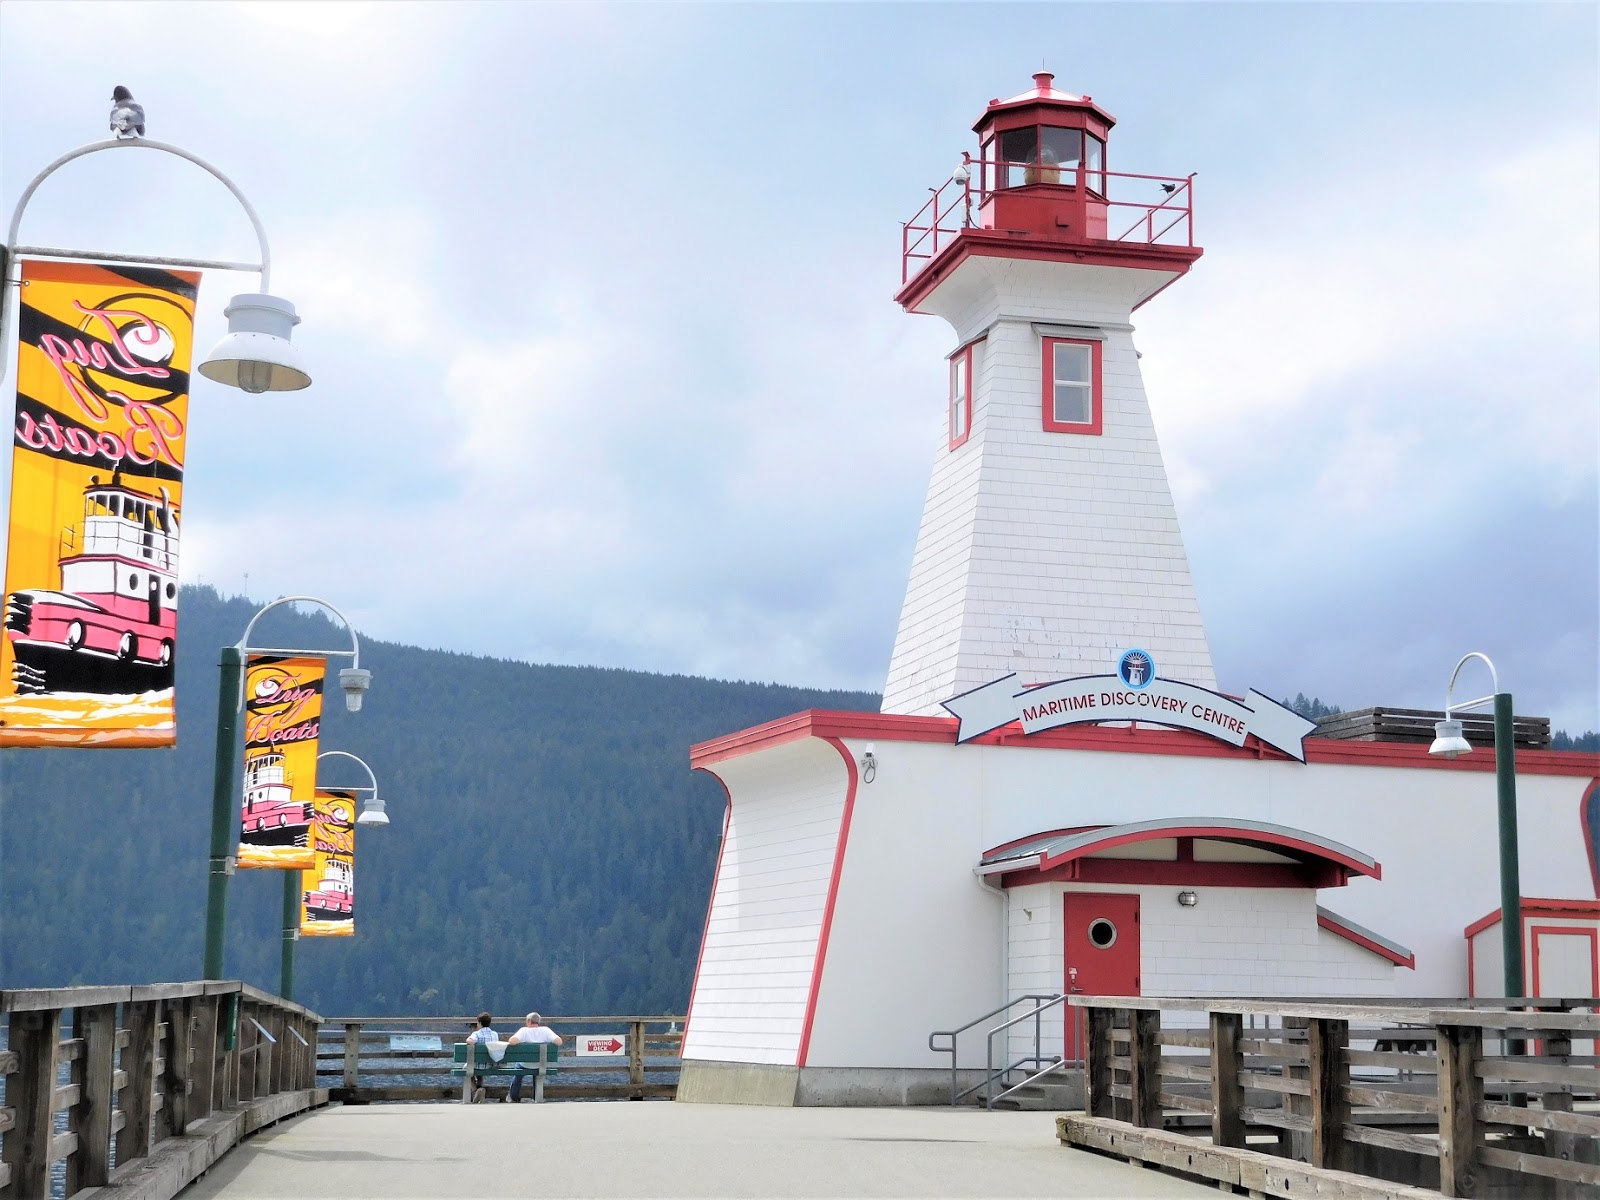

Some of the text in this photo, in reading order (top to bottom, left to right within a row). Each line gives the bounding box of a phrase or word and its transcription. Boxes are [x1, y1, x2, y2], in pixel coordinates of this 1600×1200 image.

[255, 673, 316, 724] Tug
[1022, 692, 1246, 735] MARITIME DISCOVERY CENTRE
[245, 711, 320, 744] Boats
